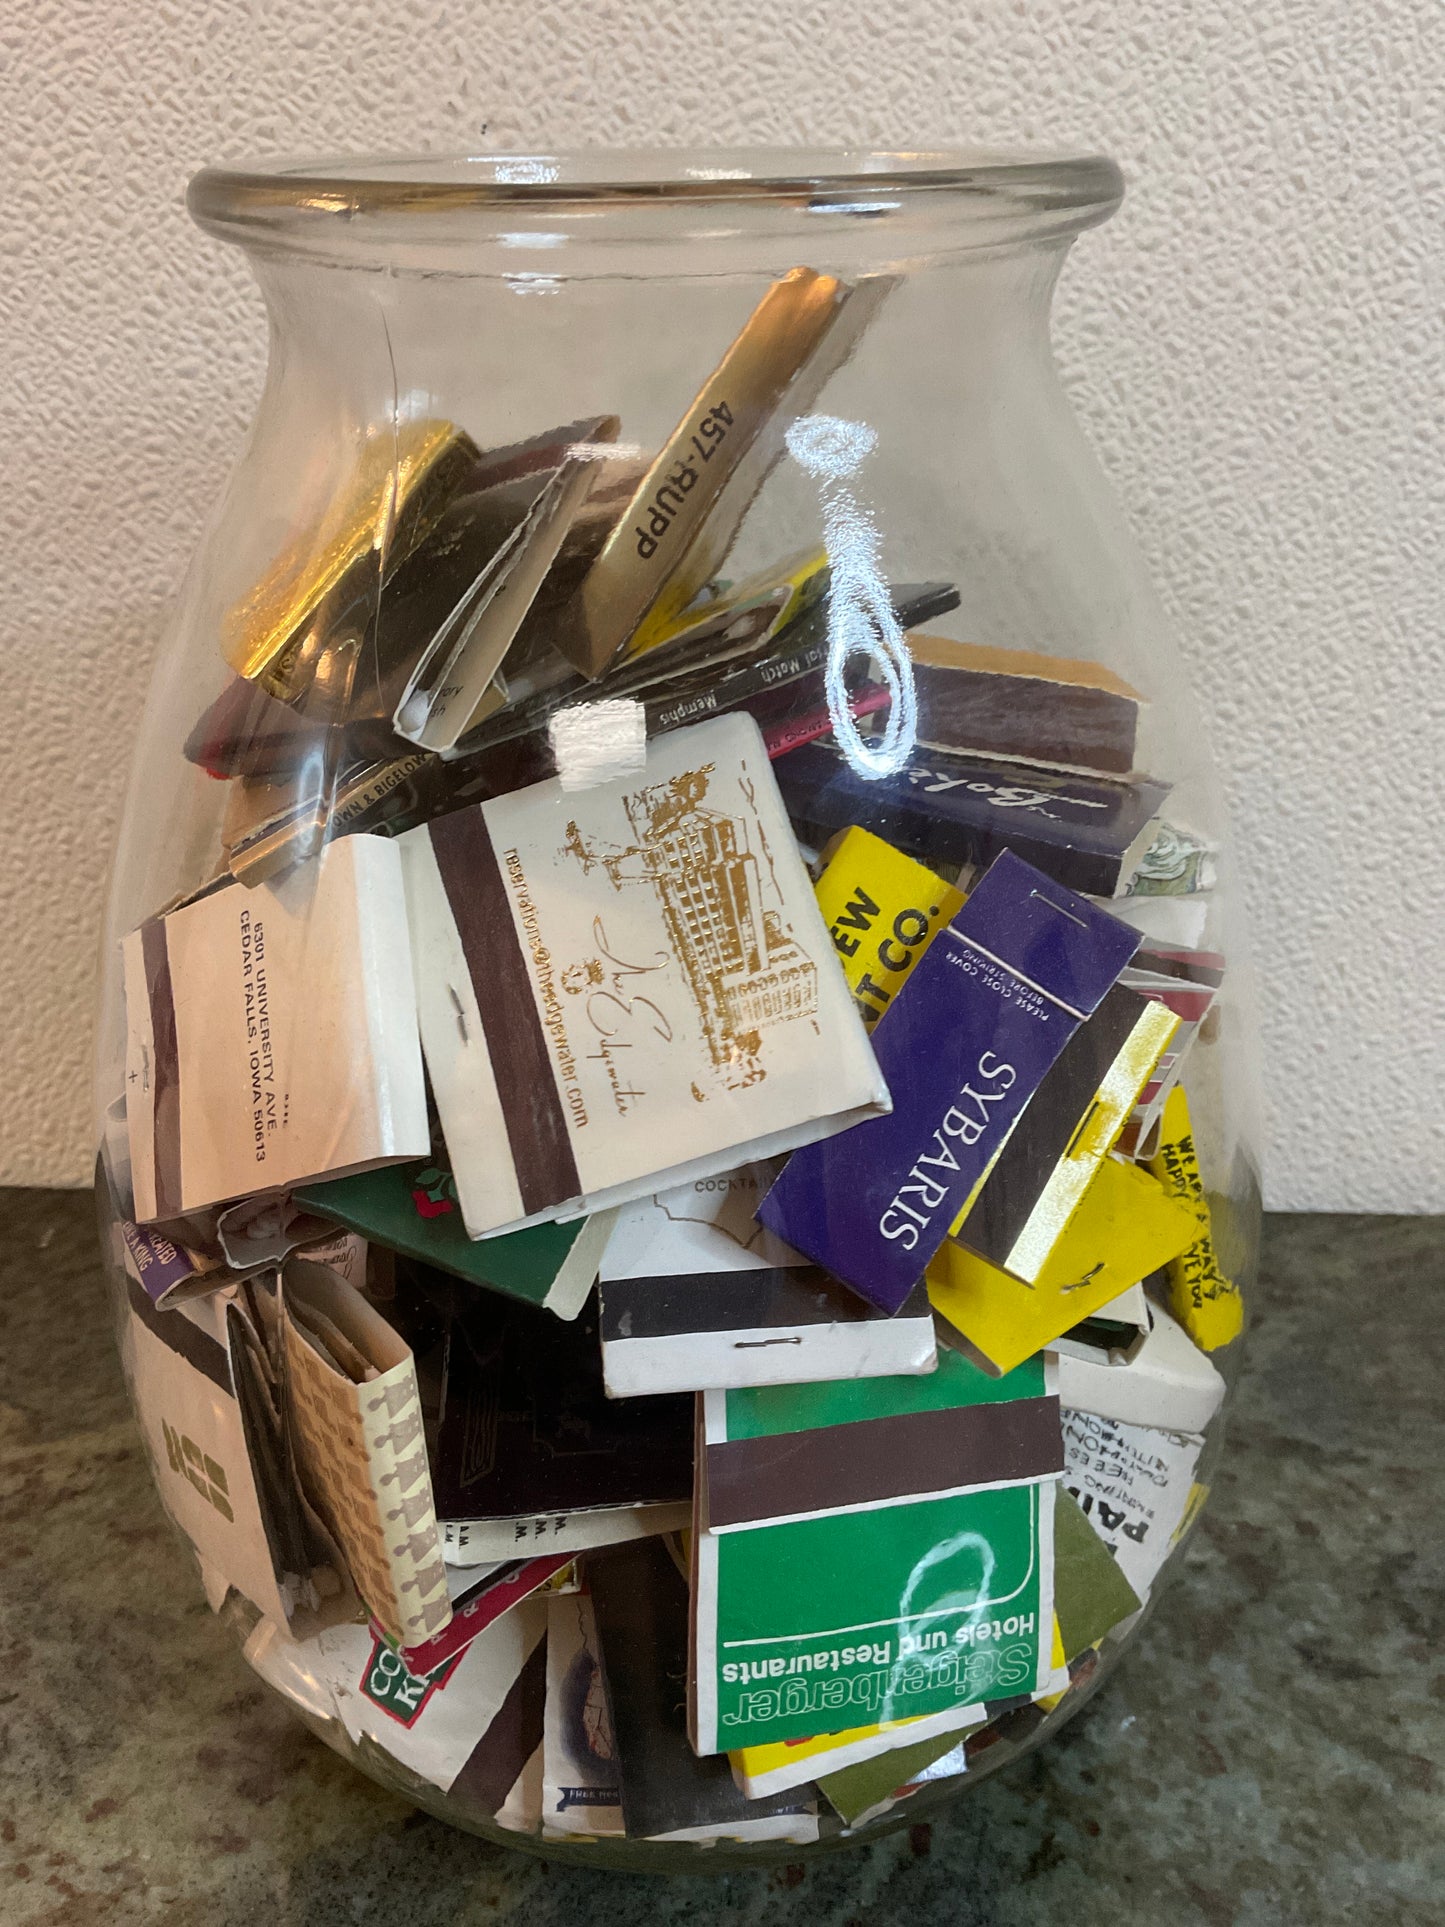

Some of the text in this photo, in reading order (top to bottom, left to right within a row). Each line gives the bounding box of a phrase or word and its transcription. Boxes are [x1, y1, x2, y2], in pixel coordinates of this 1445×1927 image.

[760, 657, 800, 683] Match
[659, 689, 717, 725] Memphis
[333, 754, 427, 827] OWN & BIGELOW
[878, 905, 939, 972] CO.
[503, 848, 590, 1129] reservations@theedgewater.com
[945, 951, 1050, 1021] PLEASE CLOSE COVER
[962, 949, 1044, 1005] BEFORE STRIKING
[240, 909, 266, 1162] CEDAR FALLS, IOWA 50613
[253, 922, 277, 1137] 6301 UNIVERSITY AVE.
[879, 1050, 1017, 1251] SYBARIS
[722, 1612, 1035, 1683] Hotels und Restaurants
[722, 1643, 1033, 1726] Steigenberger
